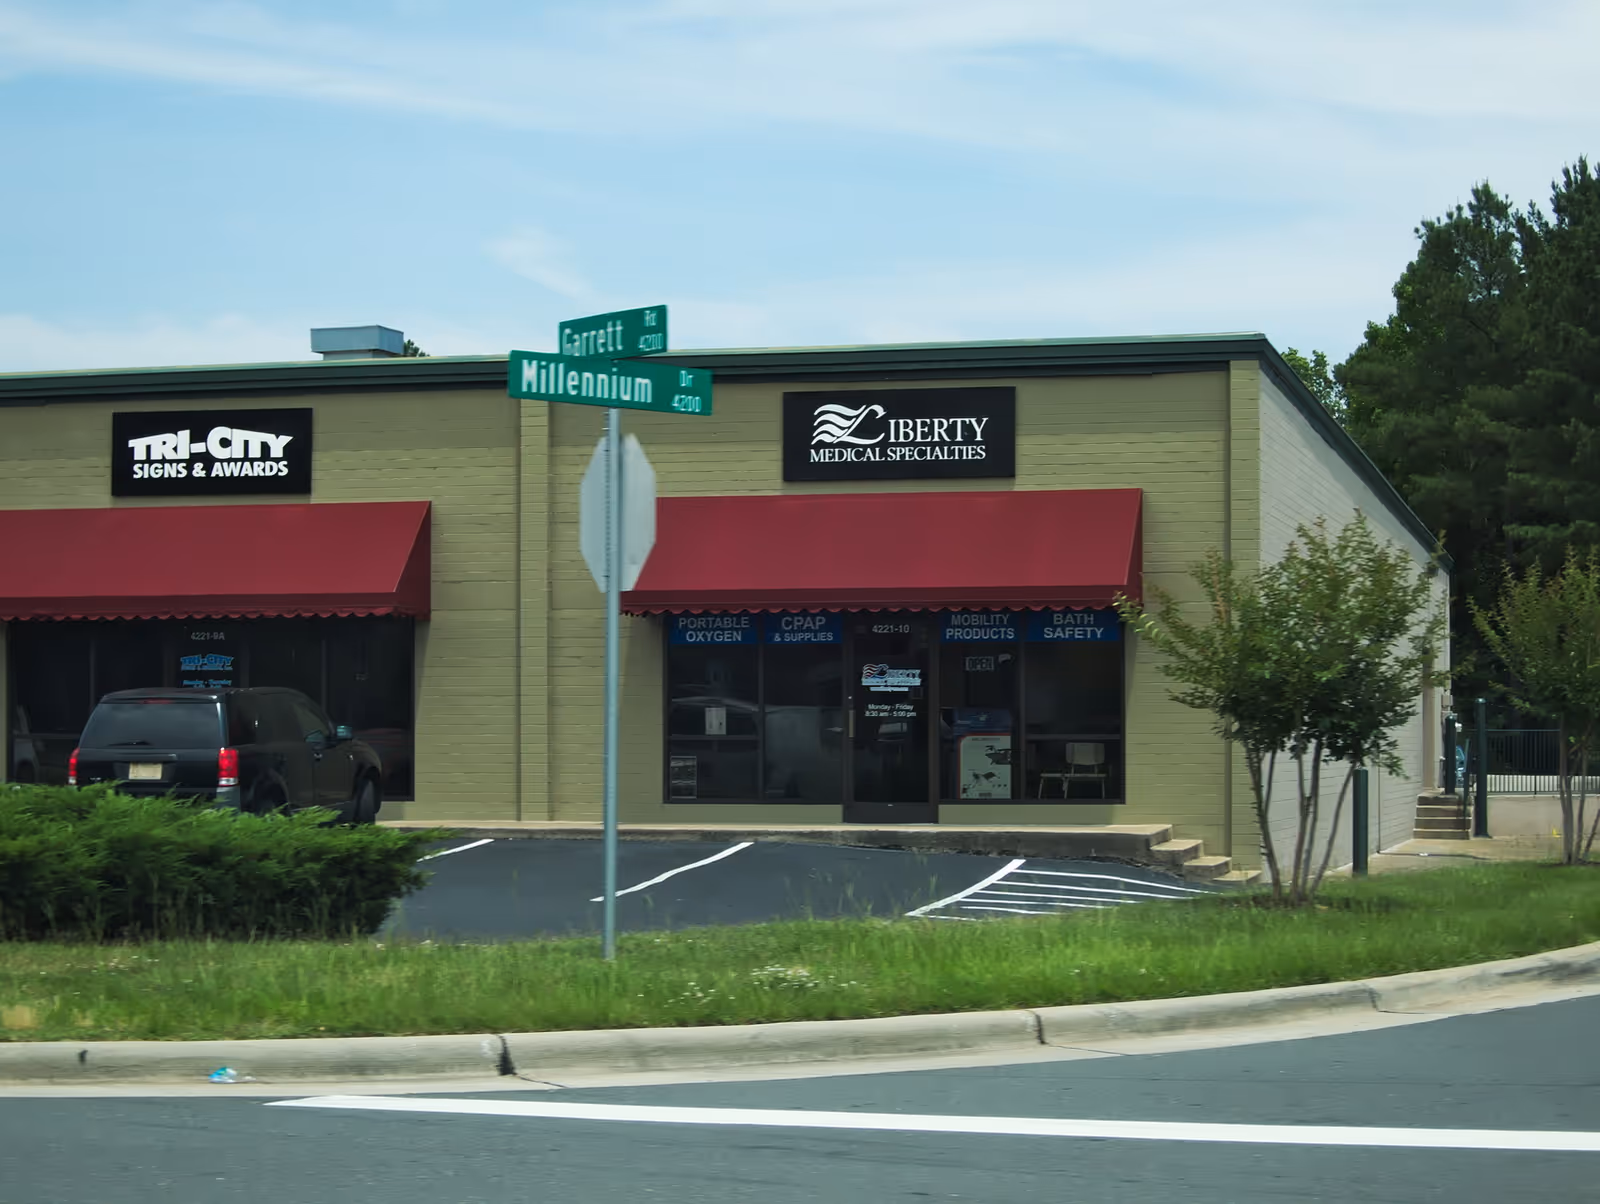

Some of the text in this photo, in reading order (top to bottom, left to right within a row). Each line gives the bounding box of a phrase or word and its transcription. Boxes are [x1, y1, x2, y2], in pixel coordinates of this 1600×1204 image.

[561, 320, 624, 357] Garrett
[638, 333, 665, 351] 4200
[521, 358, 694, 403] Millennium Dr
[672, 394, 702, 413] 4200
[831, 403, 989, 445] LIBERTY
[128, 426, 293, 461] TRI-CITY
[810, 445, 986, 463] MEDICAL SPECIALTIES
[133, 461, 289, 478] SIGNS & AWARDS
[678, 616, 750, 629] PORTABLE
[781, 616, 826, 630] CPAP
[951, 614, 1010, 626] MOBILITY
[1053, 613, 1095, 625] BATH
[872, 624, 910, 633] 4221-10
[946, 627, 1015, 640] PRODUCTS
[1043, 627, 1104, 639] SAFETY
[686, 630, 742, 642] OXYGEN
[774, 632, 833, 641] & SUPPLIES
